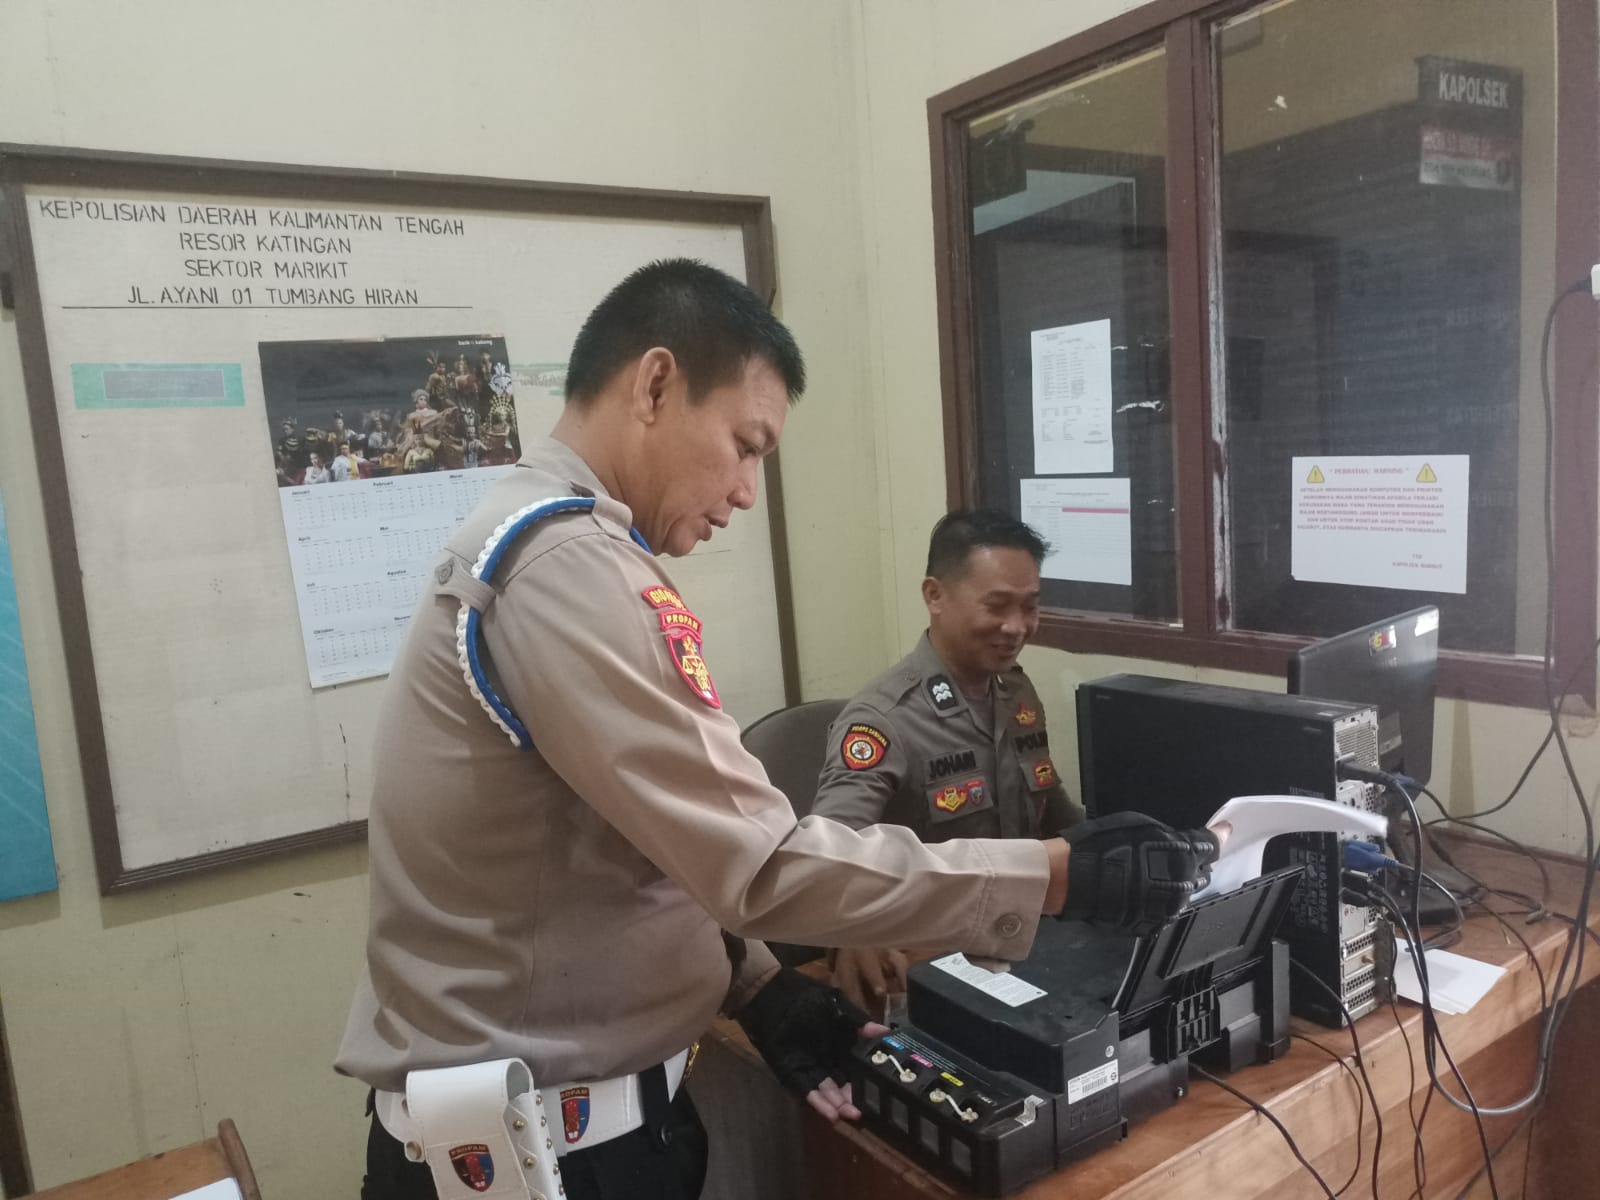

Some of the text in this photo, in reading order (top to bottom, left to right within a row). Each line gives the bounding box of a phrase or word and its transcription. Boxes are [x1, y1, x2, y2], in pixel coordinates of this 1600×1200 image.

[1439, 72, 1508, 108] KAPOLSEK
[40, 200, 465, 236] KEPOLISIAN DAERAH KALIMANTAN TENGAH
[179, 233, 351, 254] RESOR KATINGAN
[184, 259, 348, 279] SEKTOR MARIKIT
[265, 288, 355, 305] TUMBANG
[365, 288, 418, 305] HIRAN
[666, 614, 699, 630] PROPAM
